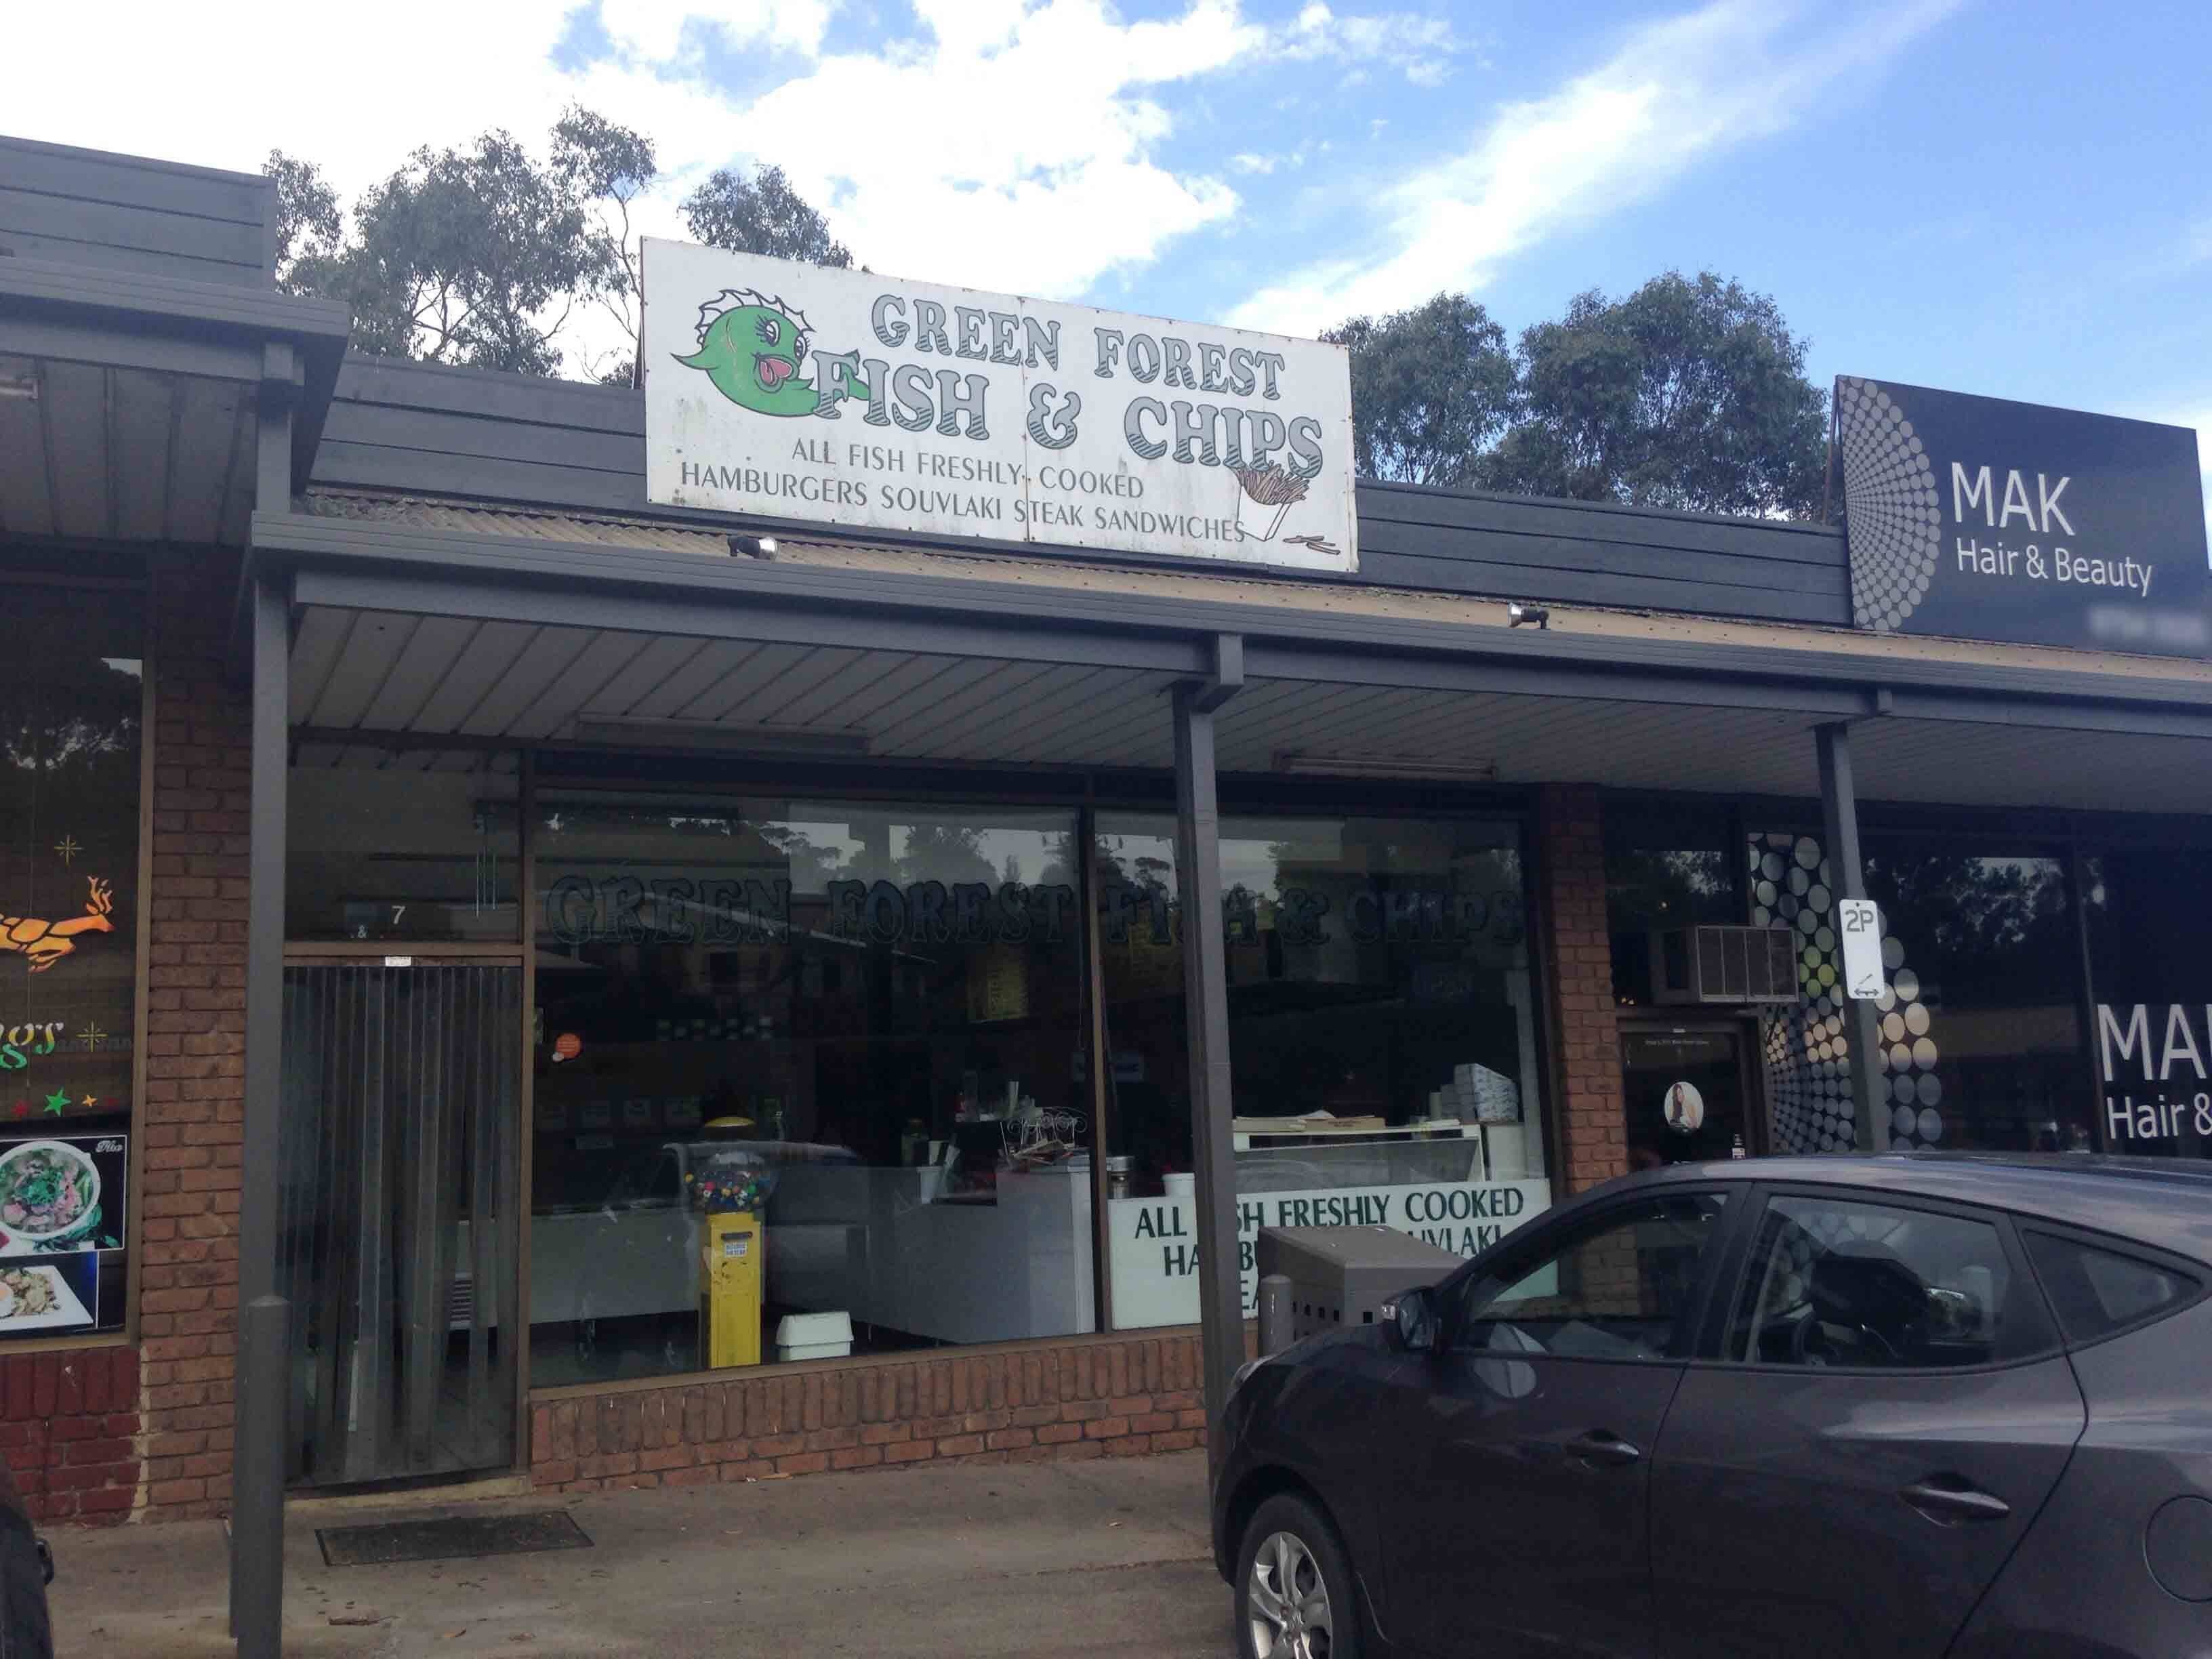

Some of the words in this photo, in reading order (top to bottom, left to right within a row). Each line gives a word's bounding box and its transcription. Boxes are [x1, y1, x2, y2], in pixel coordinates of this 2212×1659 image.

[872, 294, 1061, 371] GREEN
[1093, 327, 1284, 400] FOREST
[812, 349, 989, 441] FISH
[1027, 383, 1081, 450] &
[1124, 396, 1322, 478] CHIPS
[792, 438, 836, 465] ALL
[849, 443, 904, 472] FISH
[918, 452, 1023, 485] FRESHLY
[1040, 465, 1144, 499] COOKED
[1951, 462, 2076, 536] MAK
[681, 461, 868, 506] HAMBURGERS
[881, 485, 1002, 520] SOUVLAKI
[1014, 499, 1084, 527] STEAK
[1094, 506, 1246, 542] SANDWICHES
[1957, 537, 2019, 576] Hair
[2026, 544, 2049, 580] &
[2055, 547, 2152, 598] Beauty
[391, 905, 406, 925] 7
[547, 876, 792, 945] GREEN
[827, 880, 1073, 944] FOREST
[1106, 888, 1258, 945] FIH
[1279, 888, 1330, 945] &
[1345, 889, 1522, 945] CHIPS
[1845, 909, 1875, 933] 2P
[2097, 1004, 2212, 1082] MA
[2107, 1094, 2185, 1139] Hair
[2194, 1092, 2212, 1136] &
[1135, 1206, 1187, 1239] ALL
[1279, 1194, 1391, 1227] FRESHLY
[1405, 1187, 1523, 1222] COOKED
